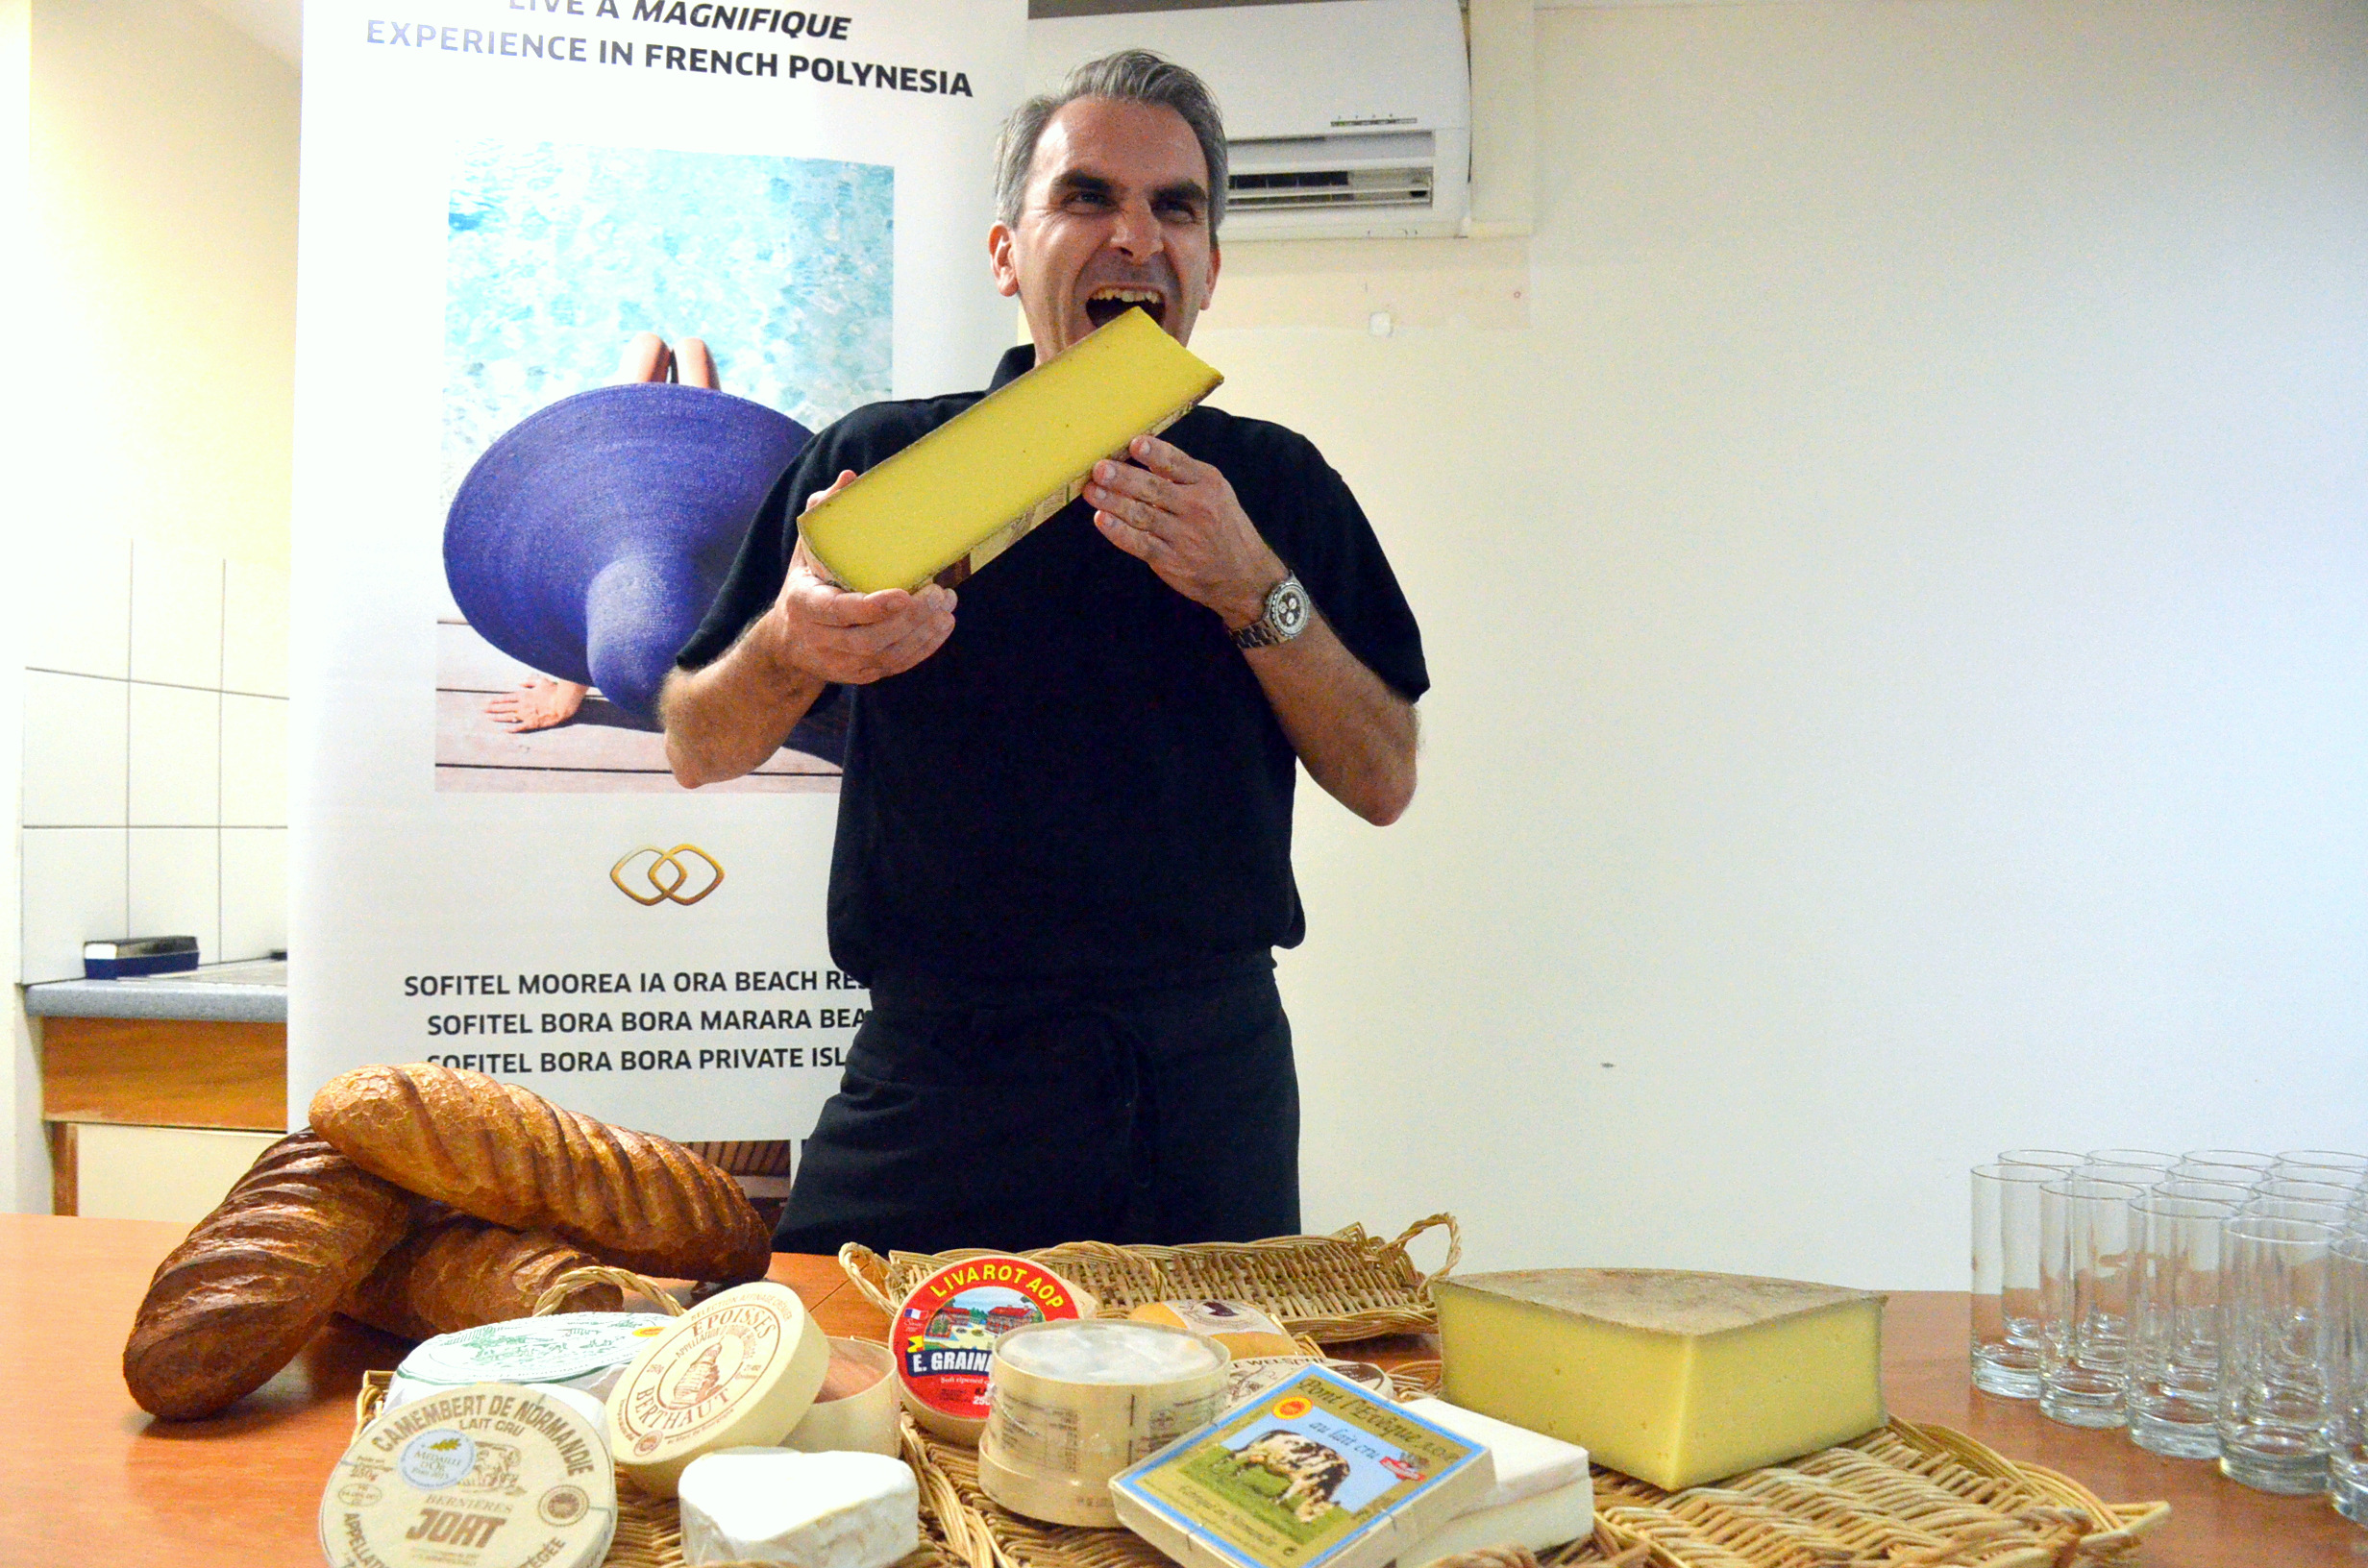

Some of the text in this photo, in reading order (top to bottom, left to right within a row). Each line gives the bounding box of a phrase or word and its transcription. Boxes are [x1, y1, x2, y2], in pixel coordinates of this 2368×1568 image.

[596, 0, 620, 19] A
[632, 0, 852, 40] MAGNIFIQUE
[366, 19, 974, 97] EXPERIENCE IN FRENCH POLYNESIA
[404, 970, 869, 996] SOFITEL MOOREA IA ORA BEACH RE
[427, 1008, 866, 1035] SOFITEL BORA BORA MARARA BEA
[541, 1051, 613, 1072] BORA
[621, 1049, 691, 1070] BORA
[700, 1047, 802, 1068] PRIVATE
[812, 1047, 846, 1067] ISL
[929, 1263, 1065, 1309] LIVAROT AOP
[458, 1418, 526, 1436] LAIT CRU
[635, 1386, 729, 1430] BERTHAUT
[371, 1394, 486, 1452] CAMEMBERT
[488, 1395, 516, 1417] DE
[514, 1401, 595, 1478] NORMANDIE
